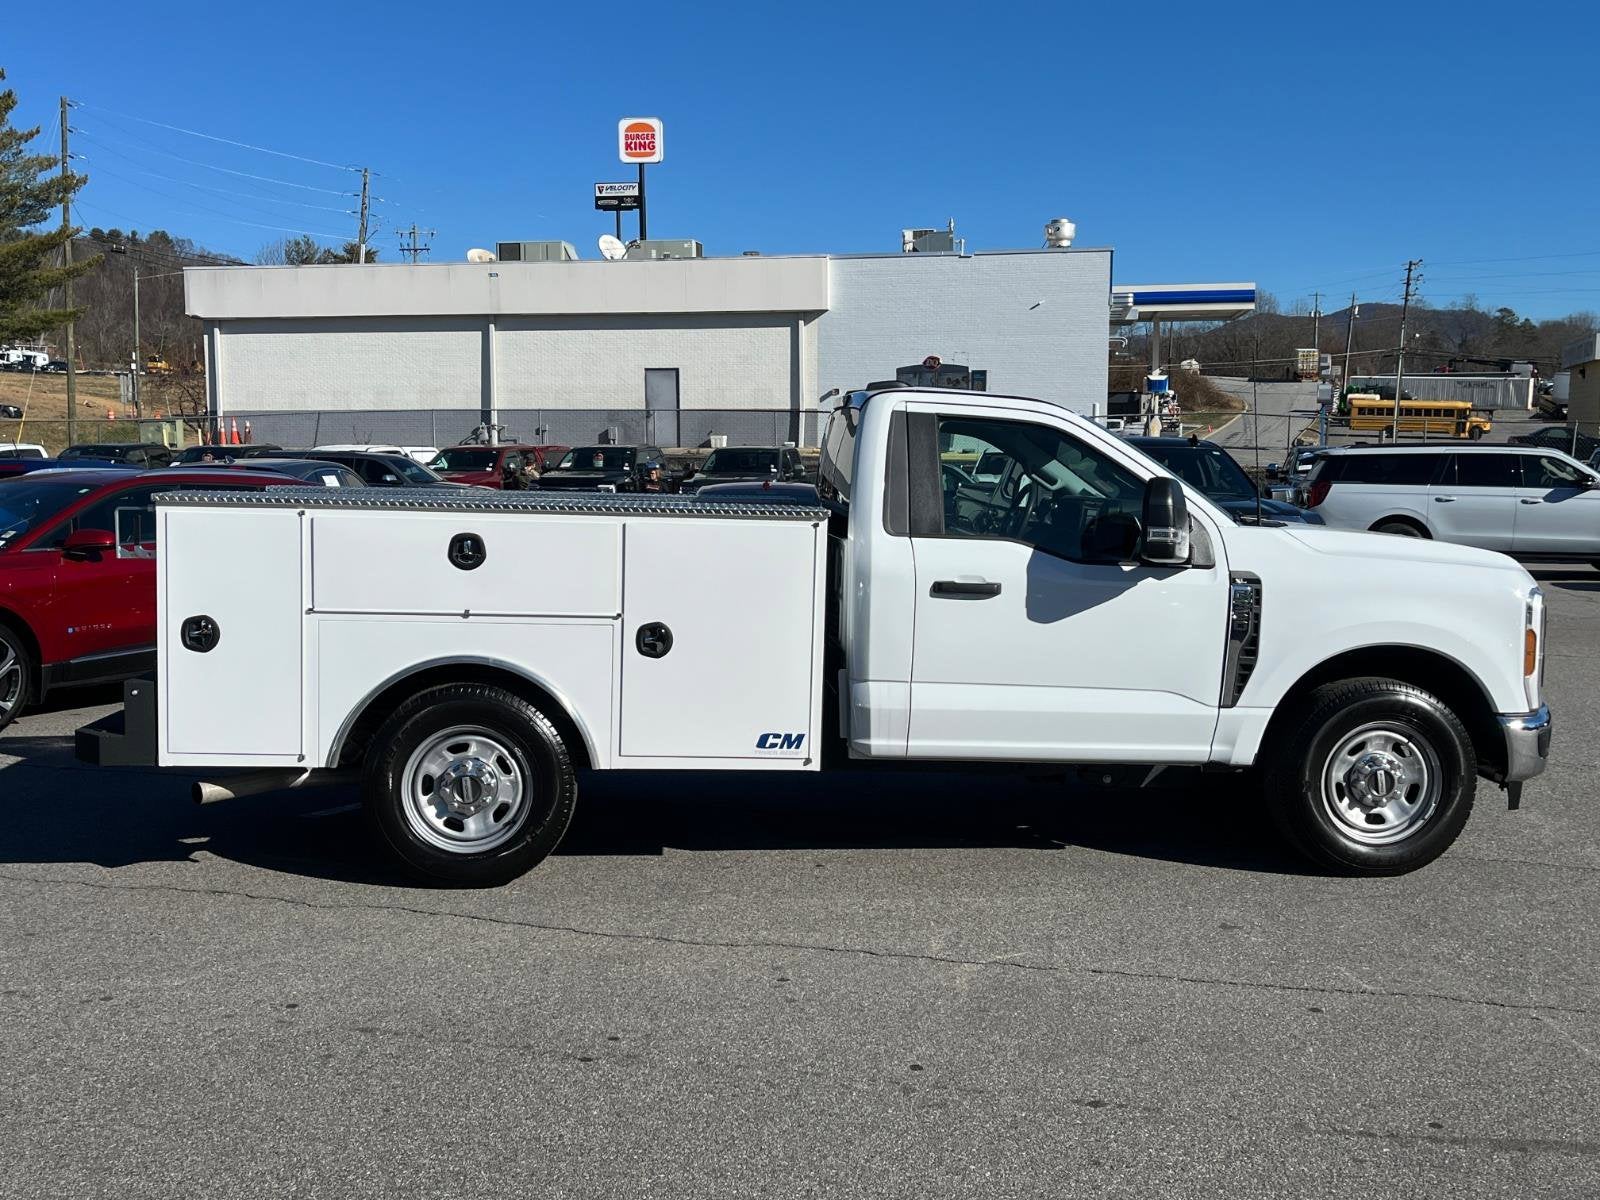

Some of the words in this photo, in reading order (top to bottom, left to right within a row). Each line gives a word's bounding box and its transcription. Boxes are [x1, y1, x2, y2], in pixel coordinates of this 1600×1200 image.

[624, 133, 656, 141] BURGER
[624, 141, 656, 151] KING
[756, 733, 806, 749] CM
